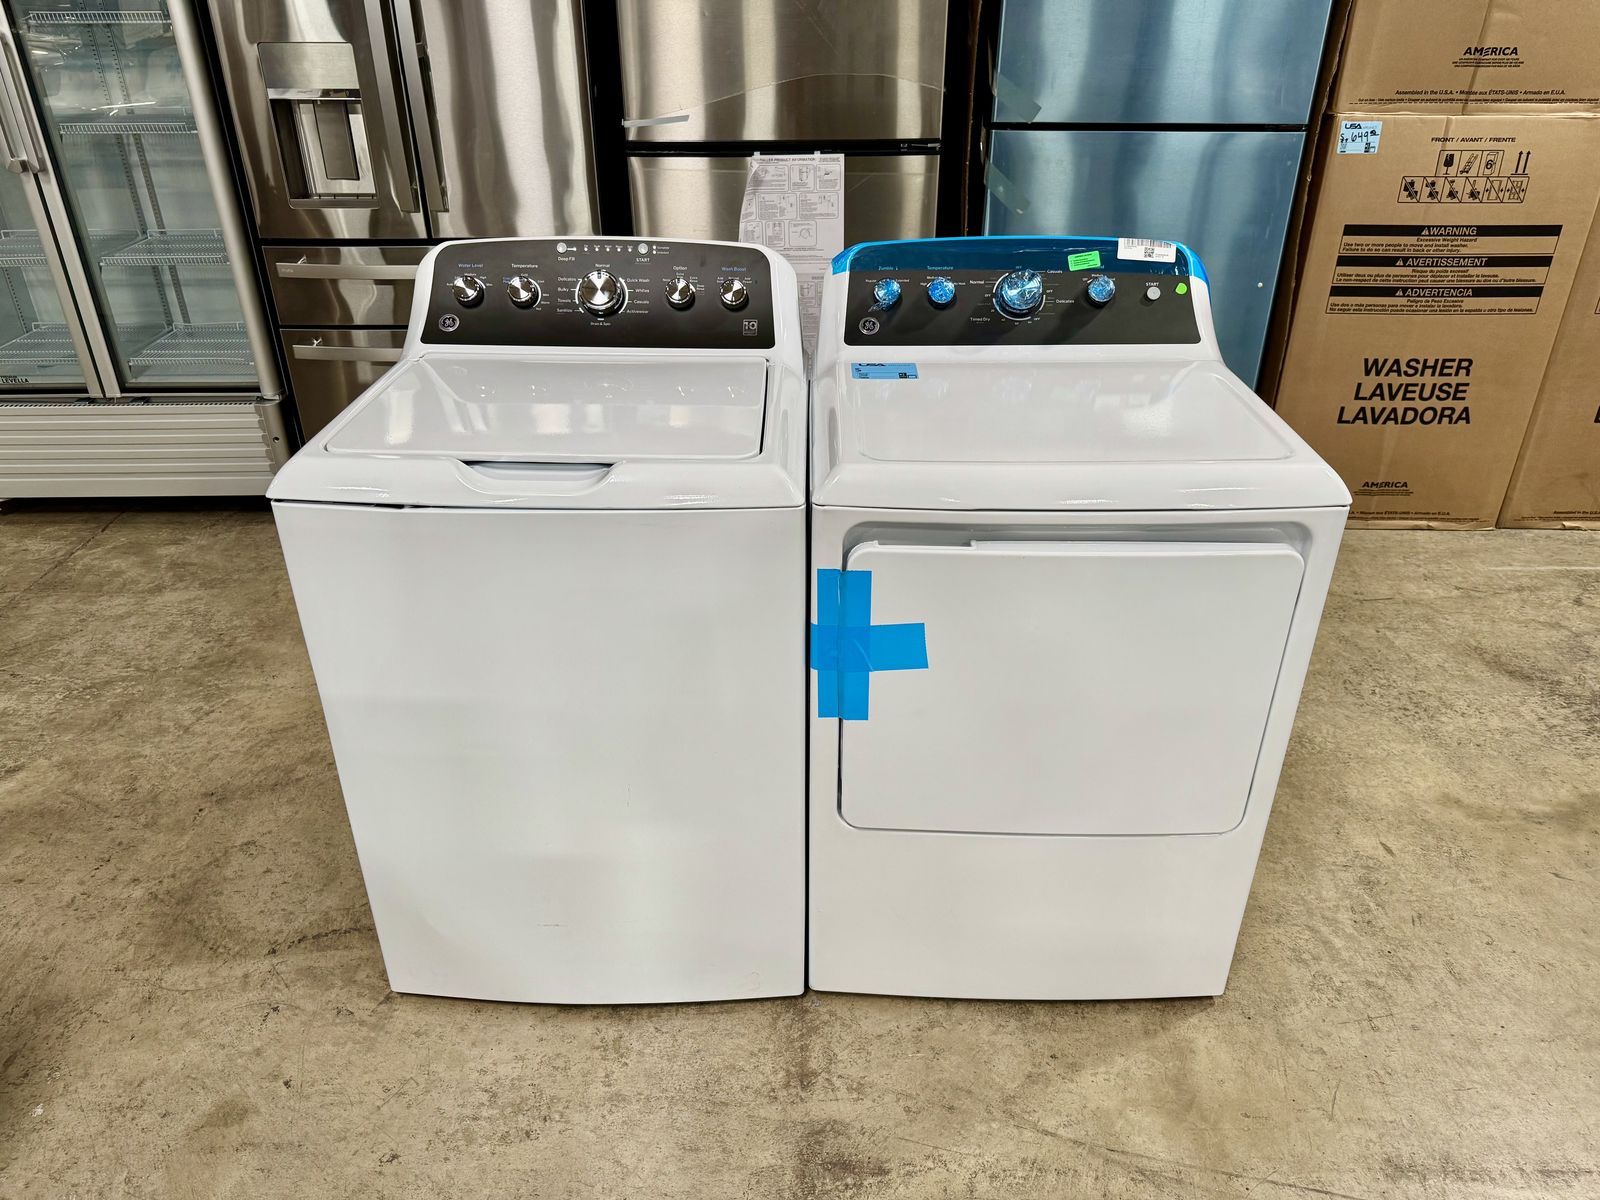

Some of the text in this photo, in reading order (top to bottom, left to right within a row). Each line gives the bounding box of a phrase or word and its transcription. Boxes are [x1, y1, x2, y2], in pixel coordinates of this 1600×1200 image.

[1463, 46, 1518, 57] AMERICA
[1430, 226, 1478, 236] WARNING
[1406, 258, 1488, 266] AVERTISSEMENT
[1405, 288, 1473, 297] ADVERTENCIA
[1363, 358, 1473, 377] WASHER
[1354, 383, 1470, 401] LAVEUSE
[1337, 406, 1471, 424] LAVADORA
